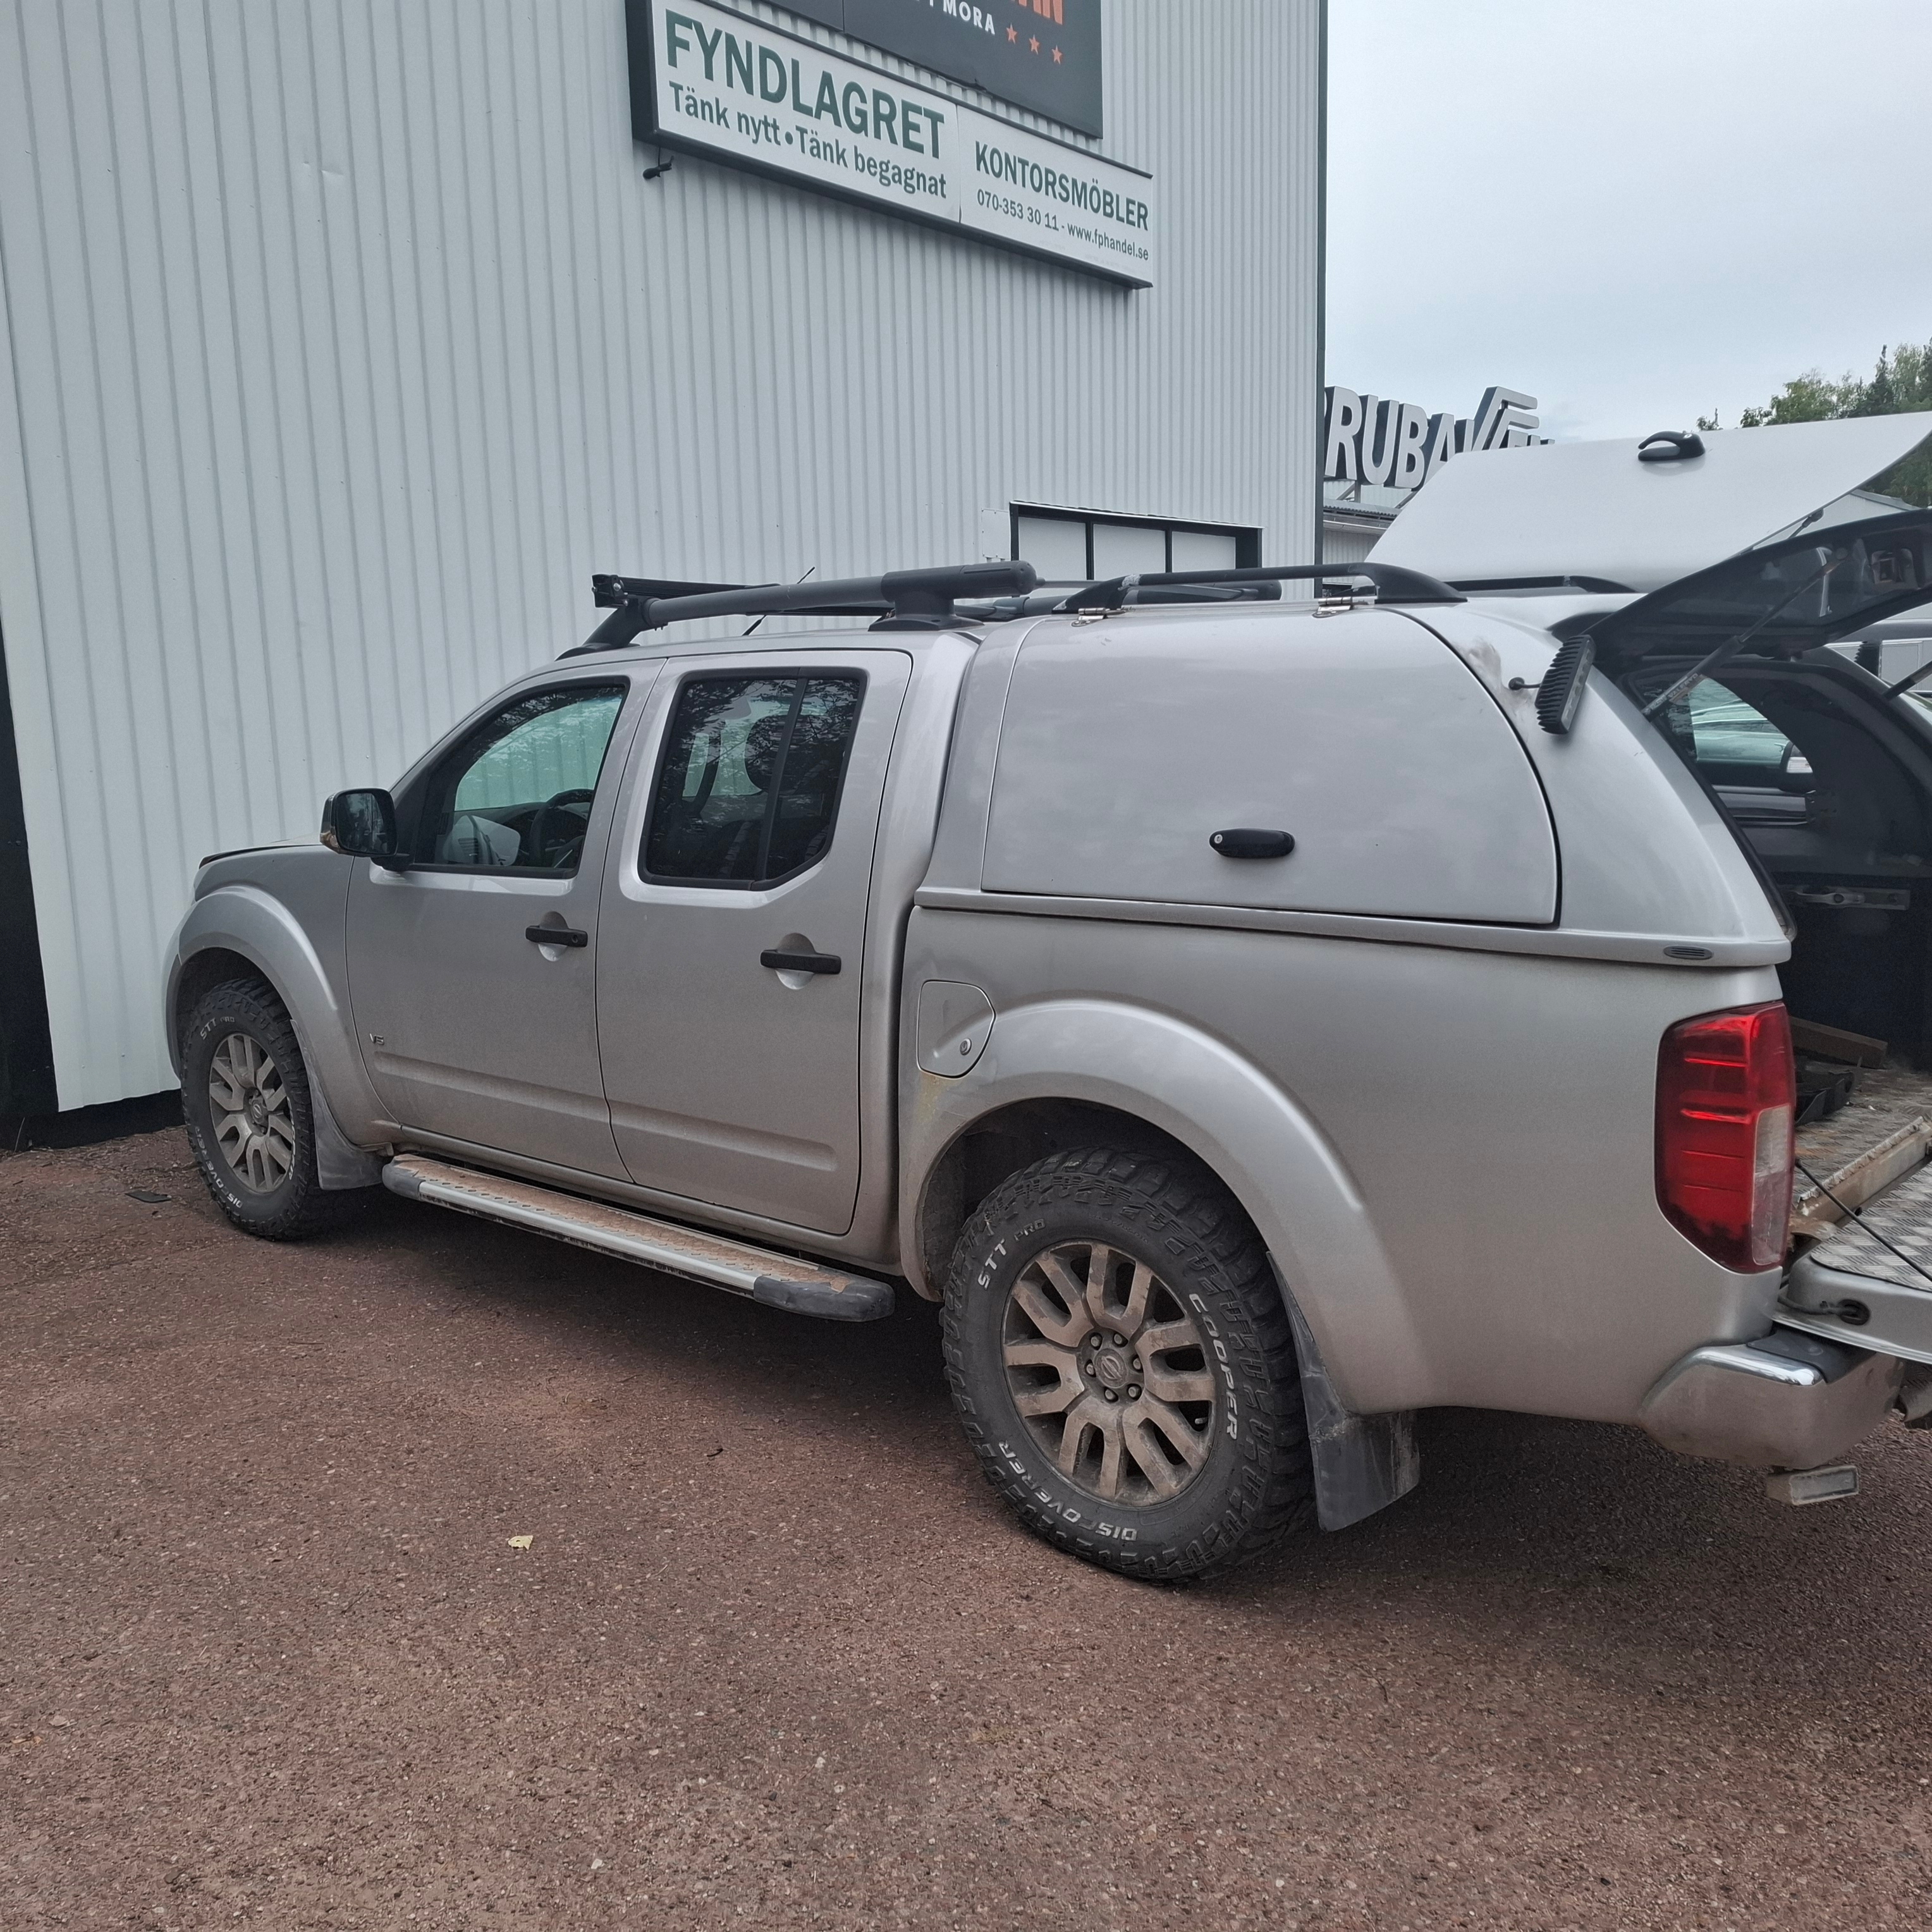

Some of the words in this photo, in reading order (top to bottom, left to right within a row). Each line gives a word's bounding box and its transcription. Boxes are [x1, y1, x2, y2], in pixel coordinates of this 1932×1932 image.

[943, 0, 995, 35] MORA
[666, 8, 945, 159] FYNDLAGRET
[669, 80, 730, 129] Tänk
[737, 111, 781, 145] nytt
[795, 125, 848, 168] Tänk
[854, 145, 946, 199] begagnat
[975, 140, 1149, 231] KONTORSMÖBLER
[977, 188, 1024, 219] 070-353
[1027, 206, 1041, 225] 30
[1044, 212, 1059, 231] 11
[1067, 223, 1149, 260] www.fphandel.se
[977, 1238, 1007, 1290] STT
[1189, 1293, 1238, 1440] COOPER
[998, 1440, 1137, 1541] DISCOVERER
